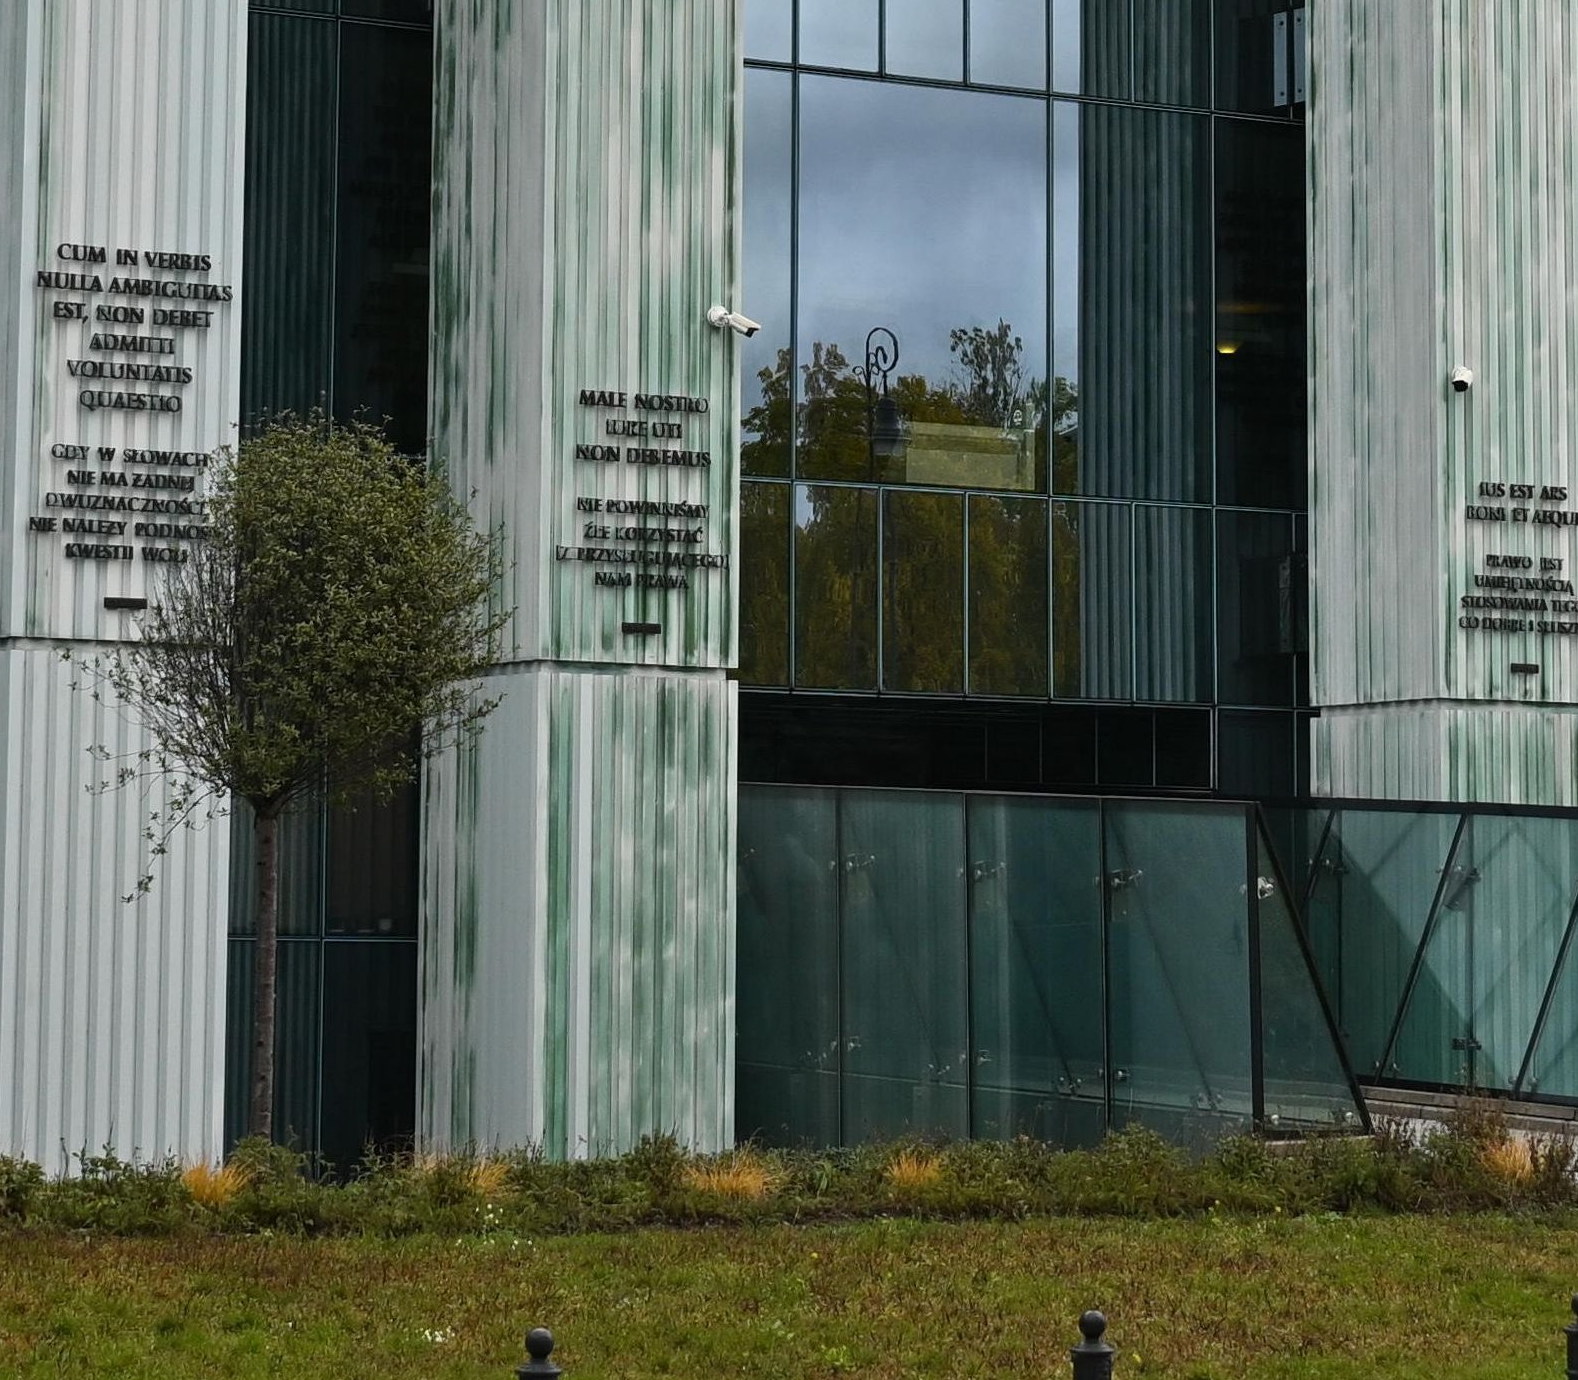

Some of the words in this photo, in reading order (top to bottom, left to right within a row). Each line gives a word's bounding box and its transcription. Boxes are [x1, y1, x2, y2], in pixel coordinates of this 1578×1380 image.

[57, 243, 106, 263] CUM
[117, 249, 138, 265] IN
[144, 251, 211, 271] VERBIS
[37, 271, 103, 292] NULLA
[108, 277, 233, 301] AMBIGUITAS
[54, 301, 88, 324] EST,
[96, 305, 144, 323] NON
[153, 309, 214, 327] DEBET
[89, 333, 175, 354] ADMITTI
[67, 359, 193, 384] VOLUNTATIS
[79, 390, 183, 412] QUAESTIO
[579, 389, 627, 408] MALE
[634, 393, 709, 413] NOSTRO
[606, 418, 647, 437] IURE
[652, 422, 683, 439] UTI
[51, 444, 90, 460] GDY
[98, 447, 115, 461] W
[123, 448, 209, 467] SŁOWACH
[576, 444, 620, 462] NON
[626, 447, 711, 468] DEBEMUS
[67, 470, 96, 485] NIE
[100, 472, 128, 486] MA
[1479, 481, 1506, 498] IUS
[1509, 483, 1536, 499] EST
[1540, 485, 1568, 502] ARS
[577, 497, 603, 512] NIE
[606, 499, 710, 519] POWINNIŚMY
[1466, 505, 1507, 522] BONI
[1512, 507, 1531, 522] ET
[29, 516, 57, 533] NIE
[134, 521, 209, 540] PODNOS
[615, 526, 703, 543] KORZYSTAĆ
[65, 542, 133, 560] KWESTII
[1486, 554, 1533, 570] PRAWO
[595, 571, 632, 587] NAM
[636, 574, 689, 589] PRAWA
[1458, 616, 1479, 629] CO
